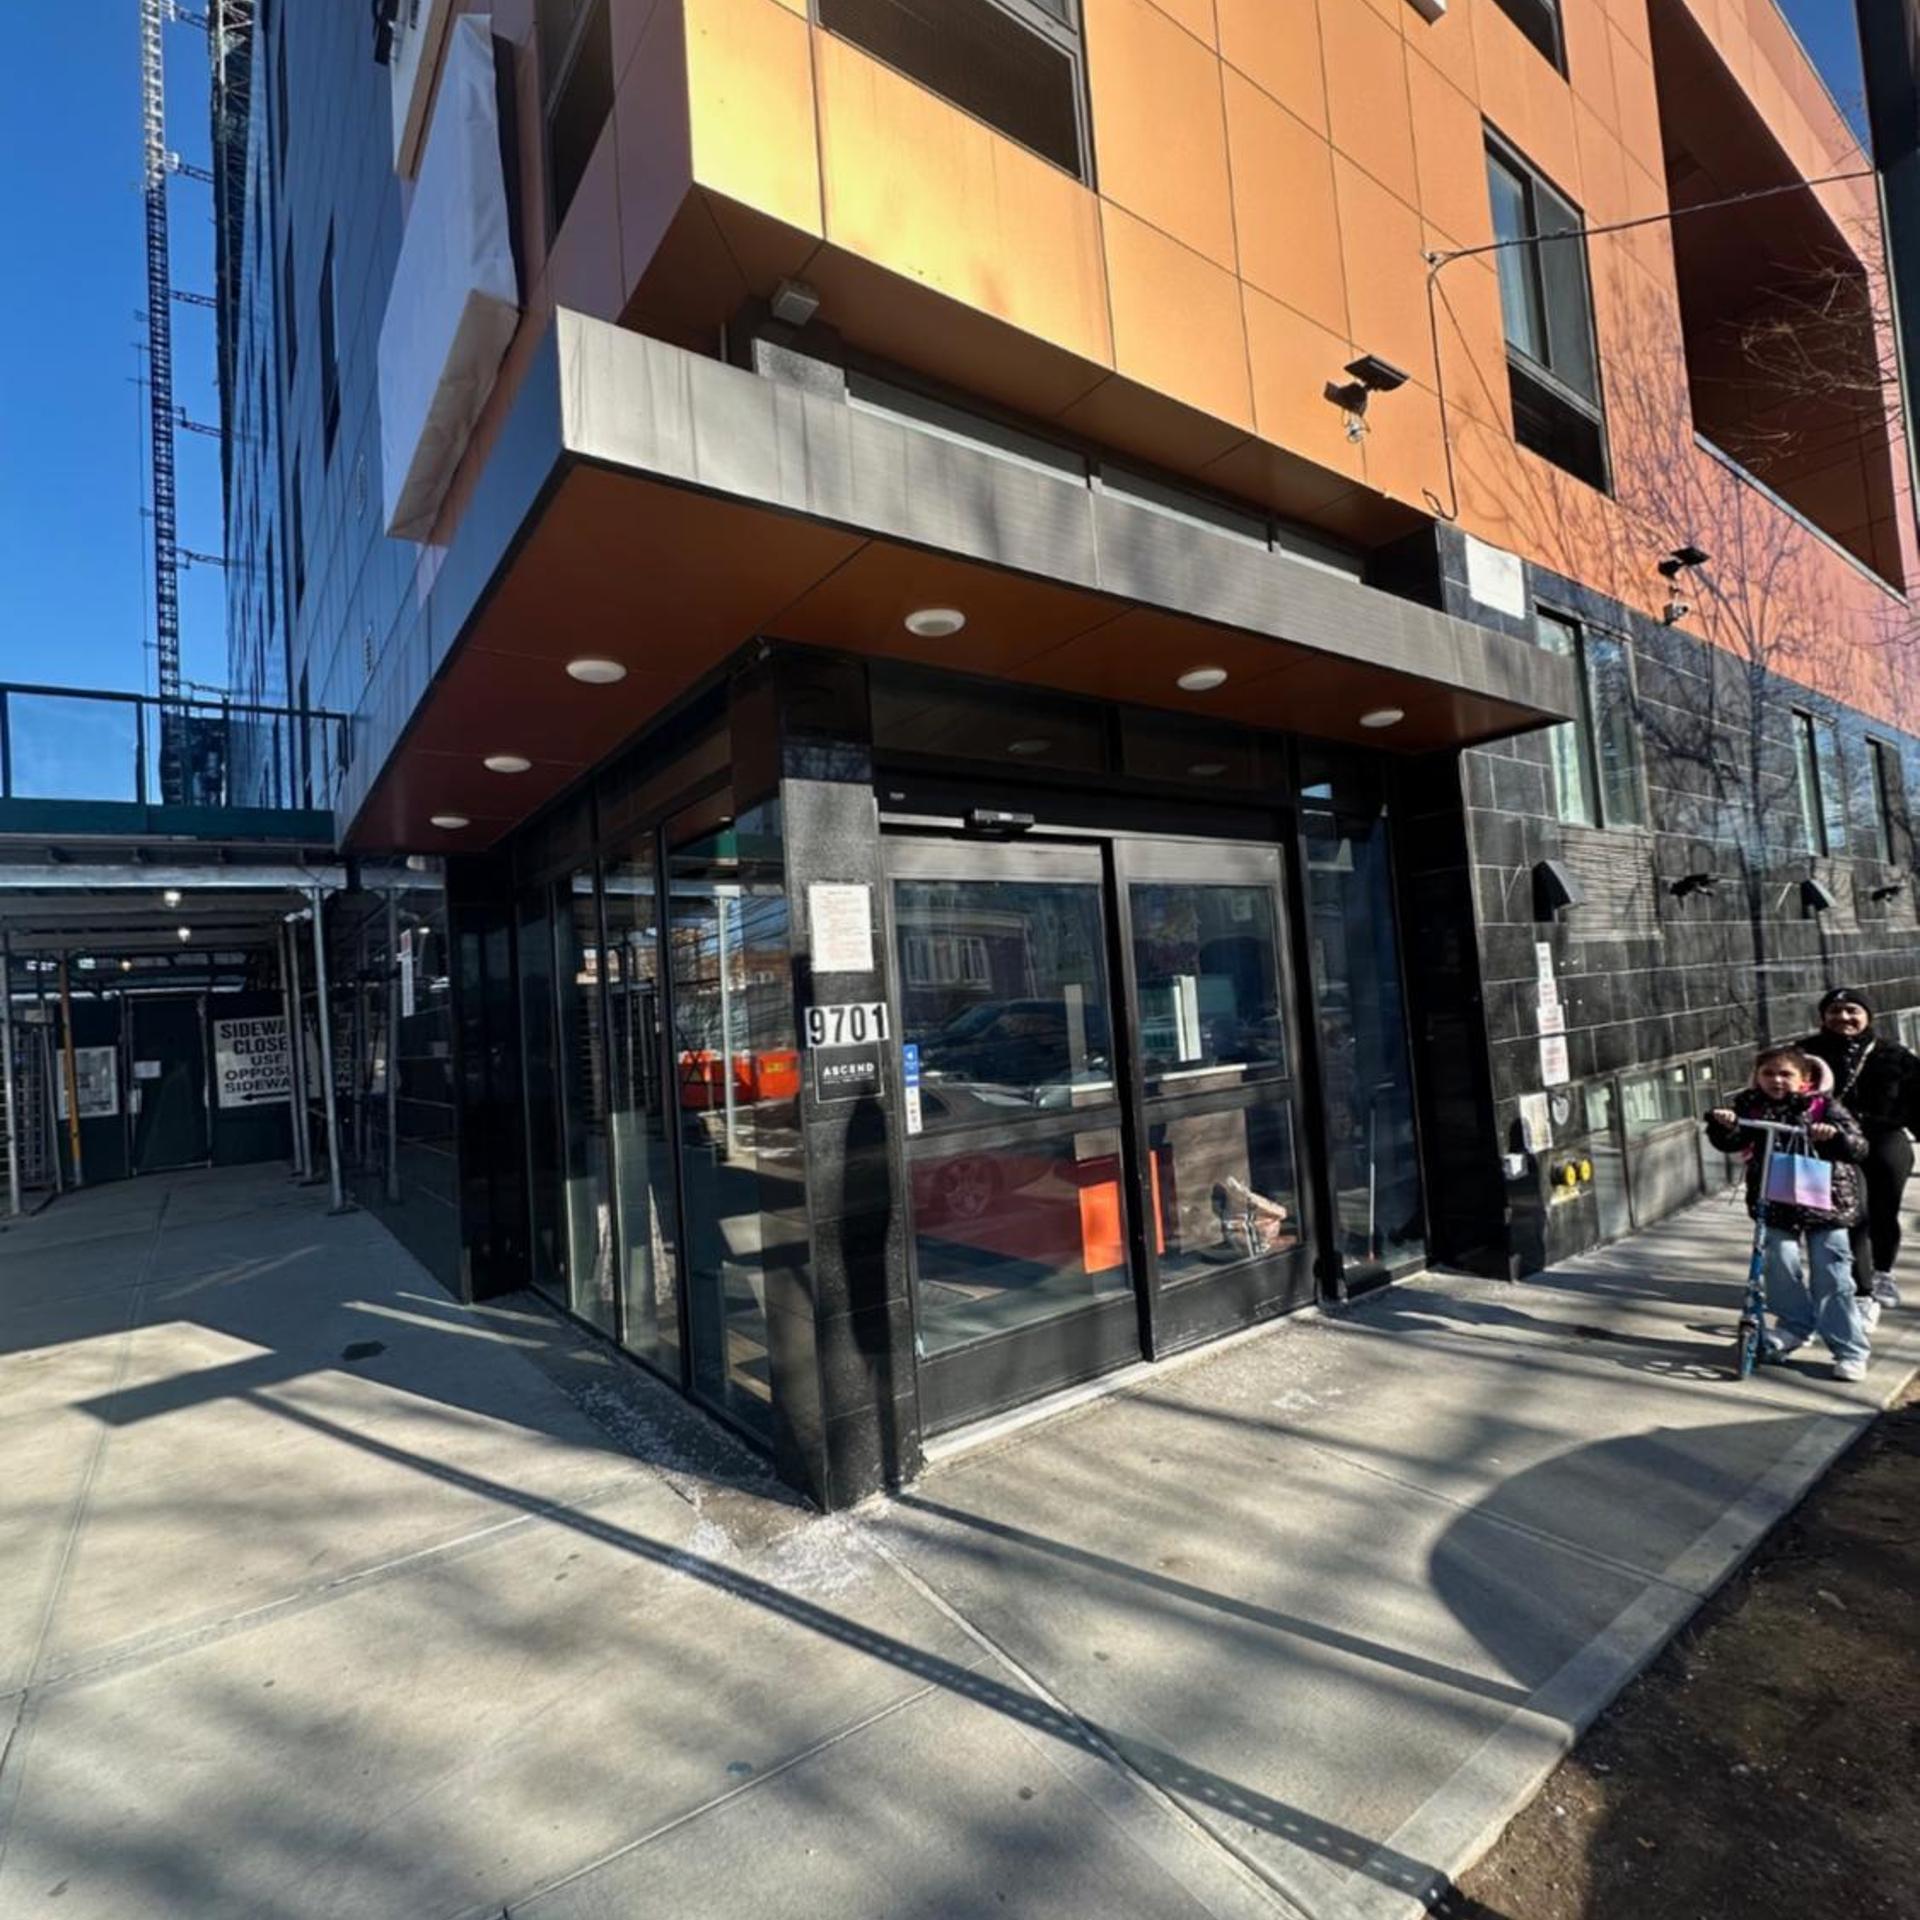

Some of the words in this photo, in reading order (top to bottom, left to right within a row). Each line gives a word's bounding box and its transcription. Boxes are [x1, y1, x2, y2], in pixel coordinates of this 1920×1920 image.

[809, 1004, 884, 1045] 9701
[233, 1035, 289, 1055] CLOSE
[823, 1062, 875, 1076] ASCEND
